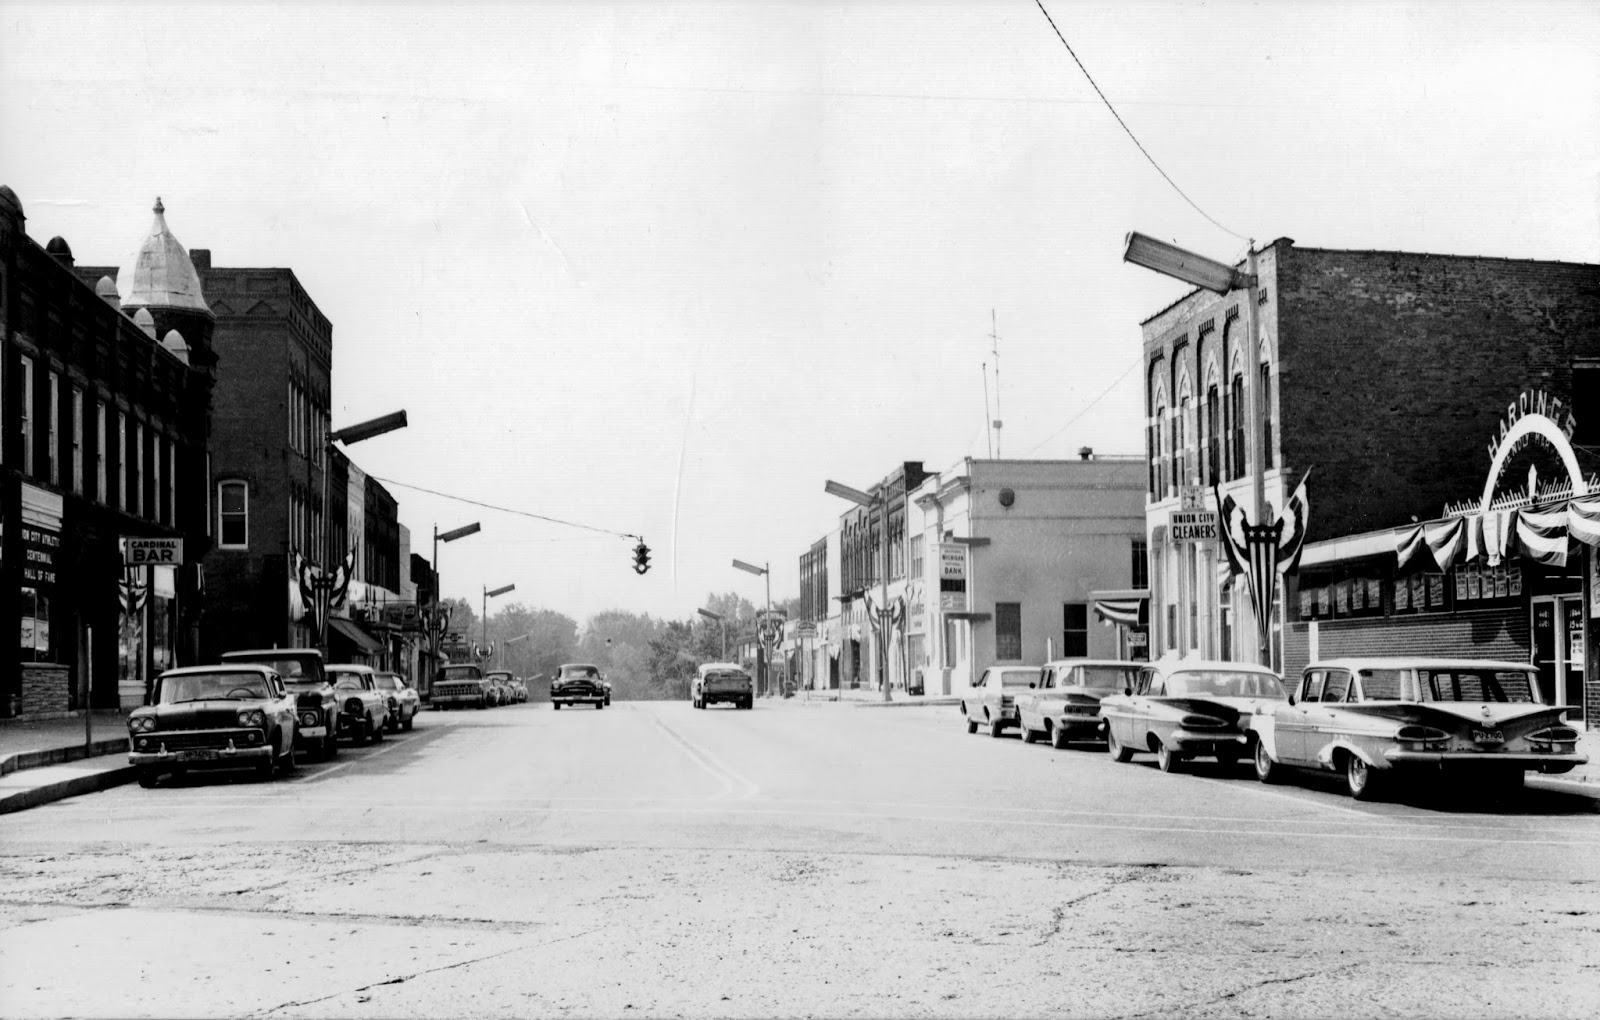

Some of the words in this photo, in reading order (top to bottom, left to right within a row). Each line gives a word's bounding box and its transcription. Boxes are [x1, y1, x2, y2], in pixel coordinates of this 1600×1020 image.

[1173, 513, 1196, 523] UNION
[1199, 513, 1215, 523] CITY
[30, 531, 41, 542] CITY
[1173, 524, 1217, 540] CLEANERS
[131, 541, 176, 549] CARDINAL
[133, 549, 173, 561] BAR
[24, 568, 36, 580] HALL
[37, 570, 43, 580] OF
[944, 567, 962, 575] BANK
